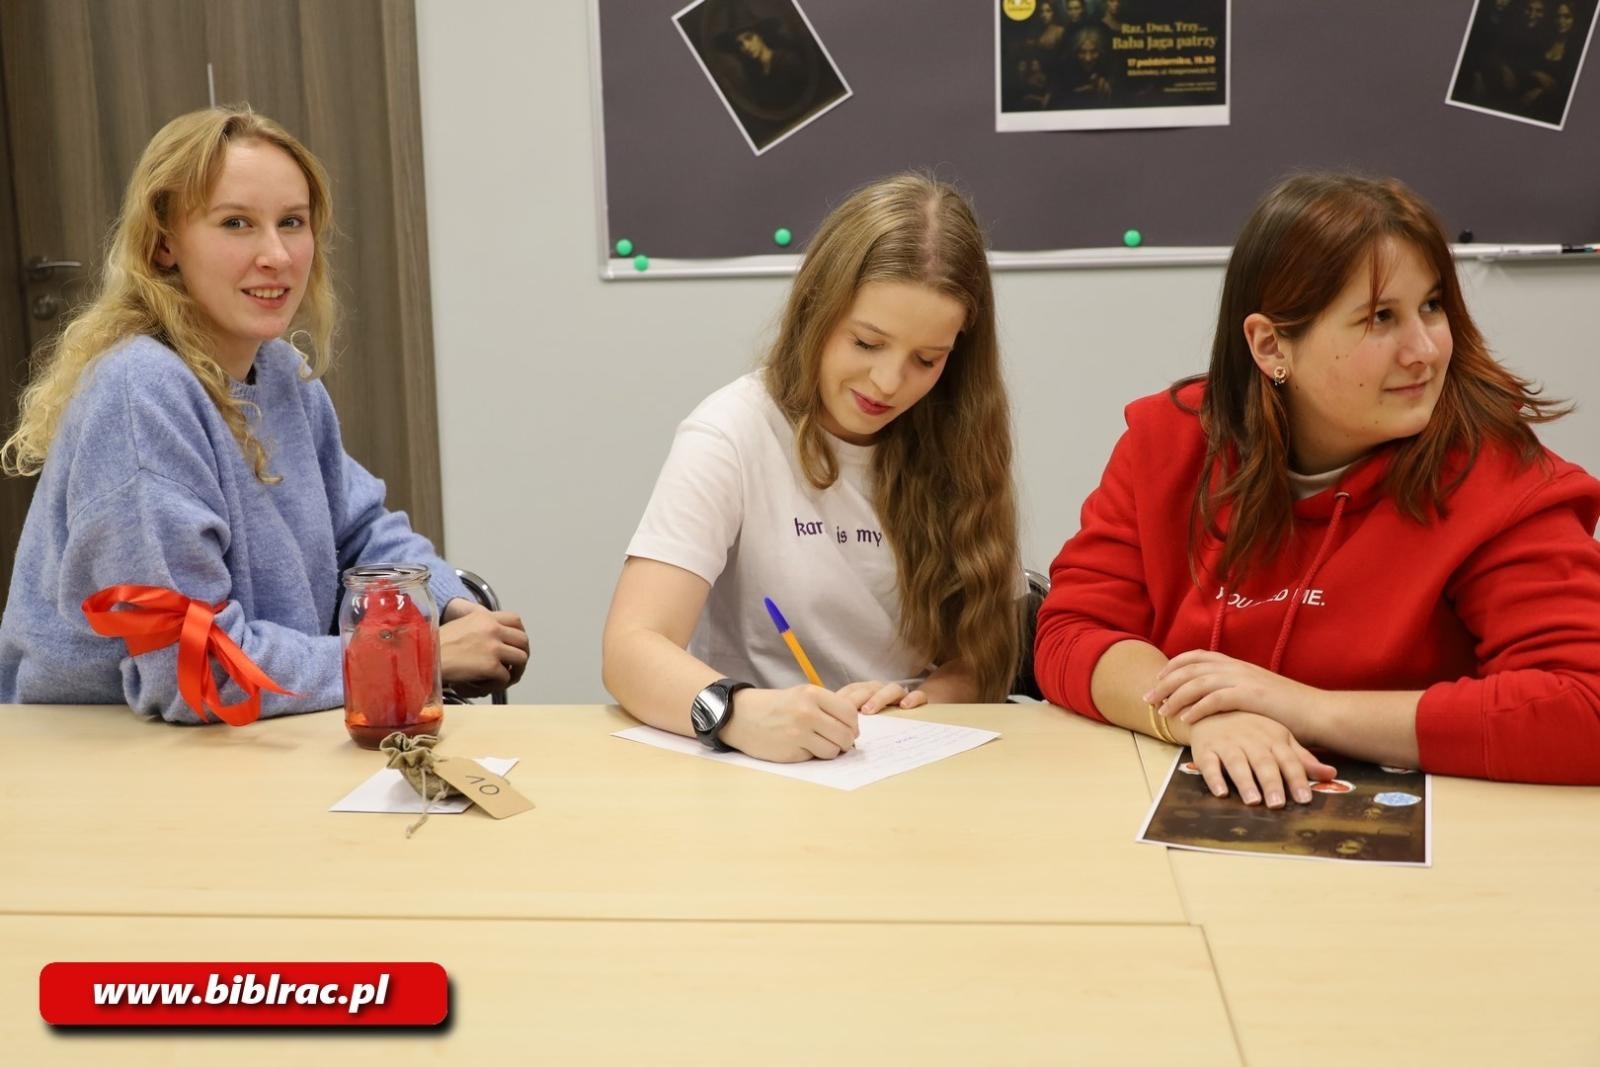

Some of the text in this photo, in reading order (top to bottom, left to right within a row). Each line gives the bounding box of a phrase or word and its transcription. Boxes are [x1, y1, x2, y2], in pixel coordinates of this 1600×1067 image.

[1112, 36, 1217, 51] Baba Jaga patrzy
[794, 517, 883, 547] kar is my
[465, 774, 500, 796] 10
